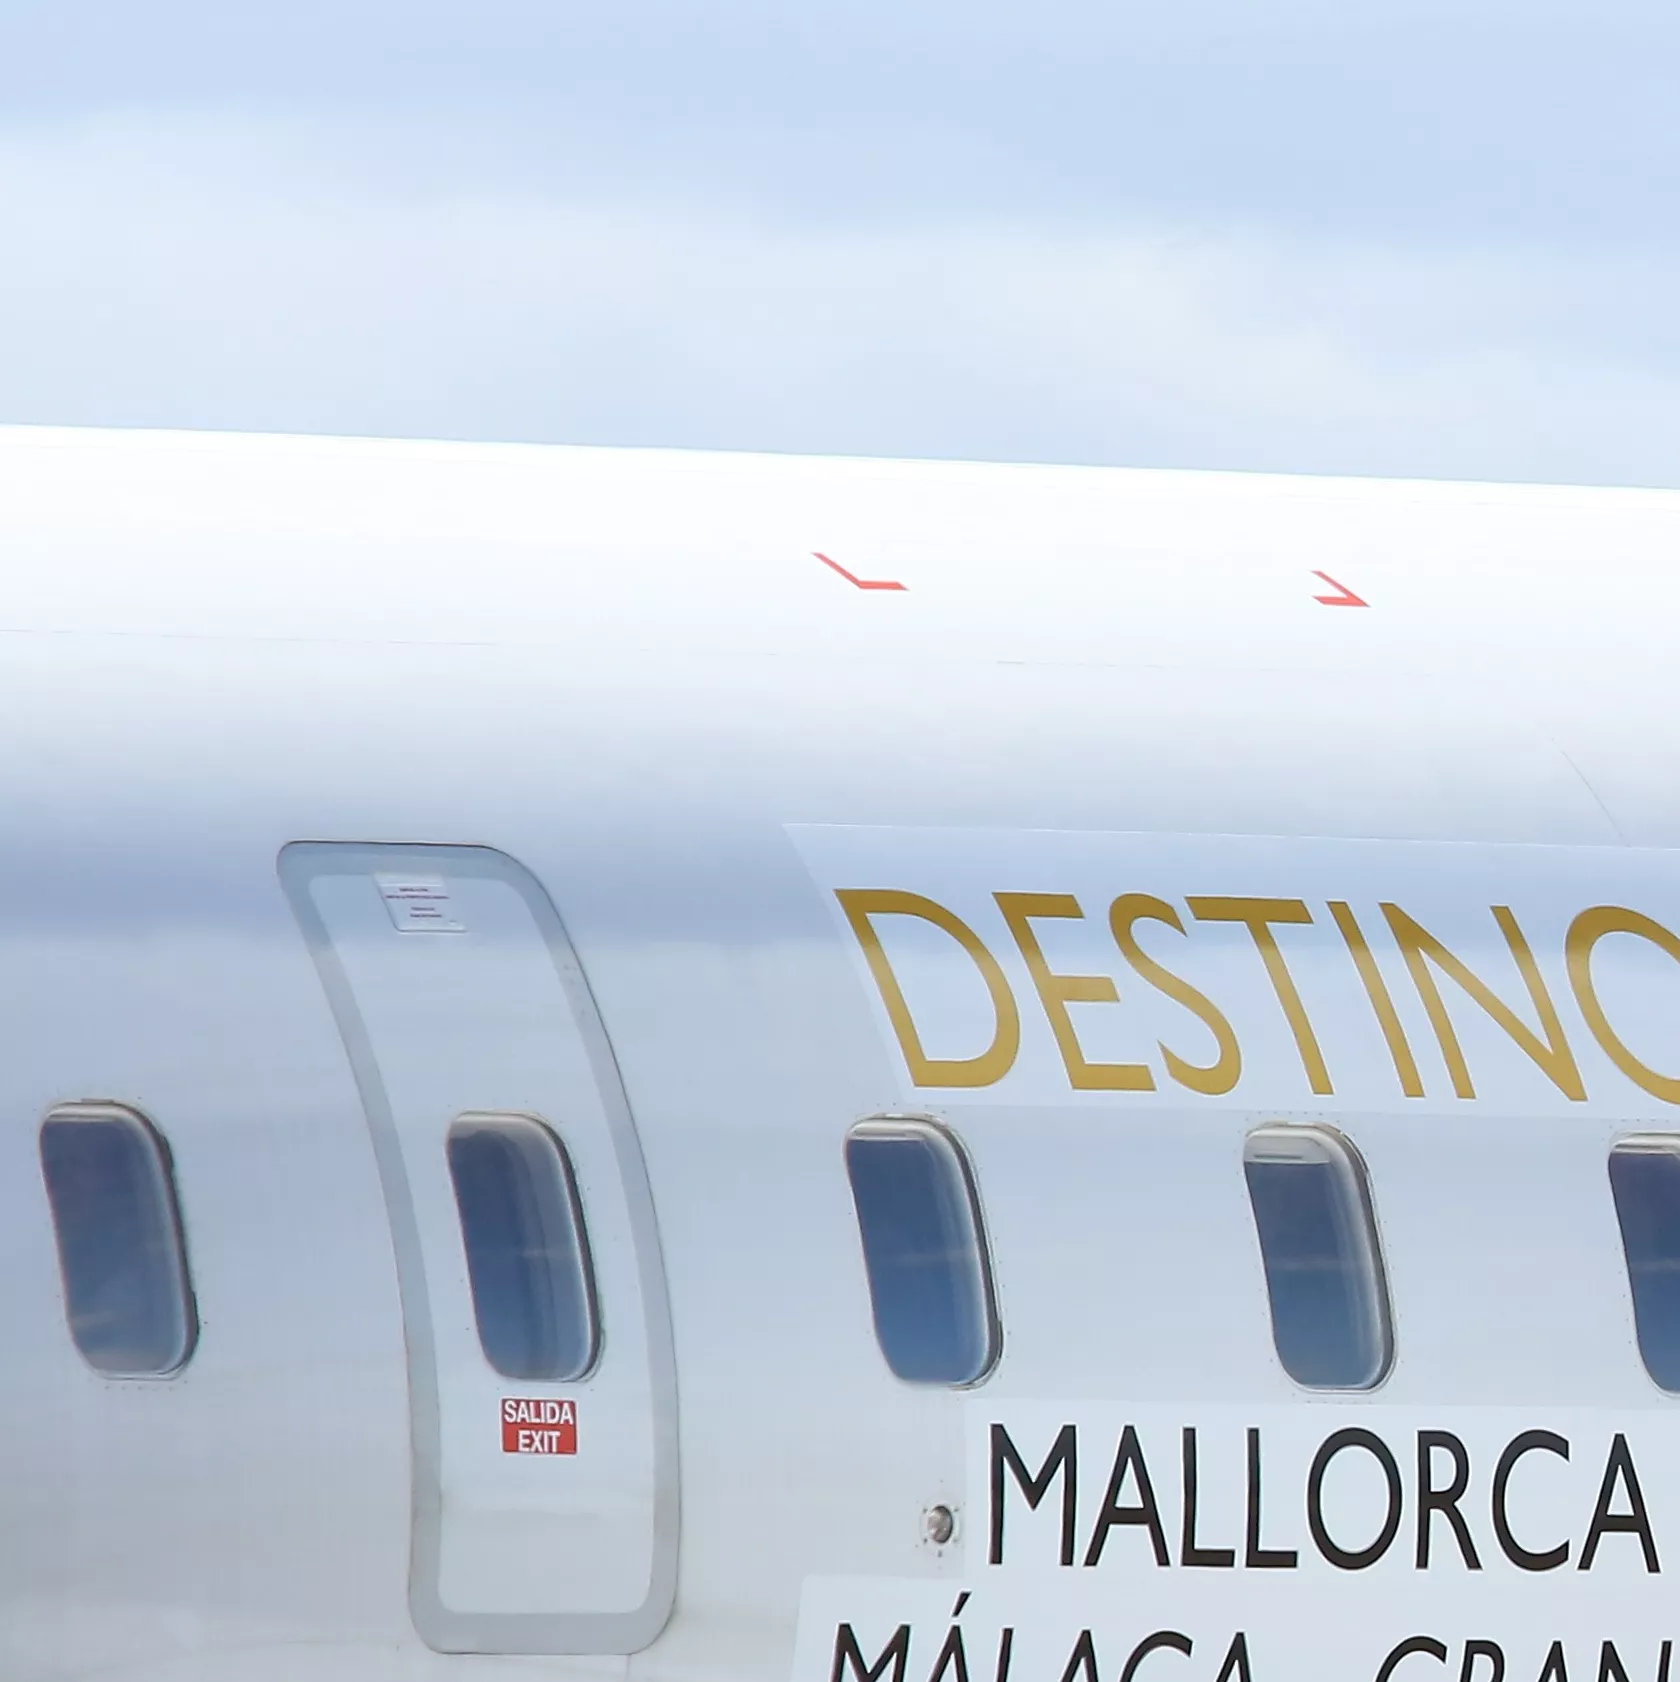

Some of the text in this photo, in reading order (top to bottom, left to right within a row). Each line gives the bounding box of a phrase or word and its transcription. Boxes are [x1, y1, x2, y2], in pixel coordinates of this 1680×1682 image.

[503, 1399, 574, 1425] SALIDA
[518, 1429, 561, 1453] EXIT
[988, 1422, 1663, 1575] MALLORCA
